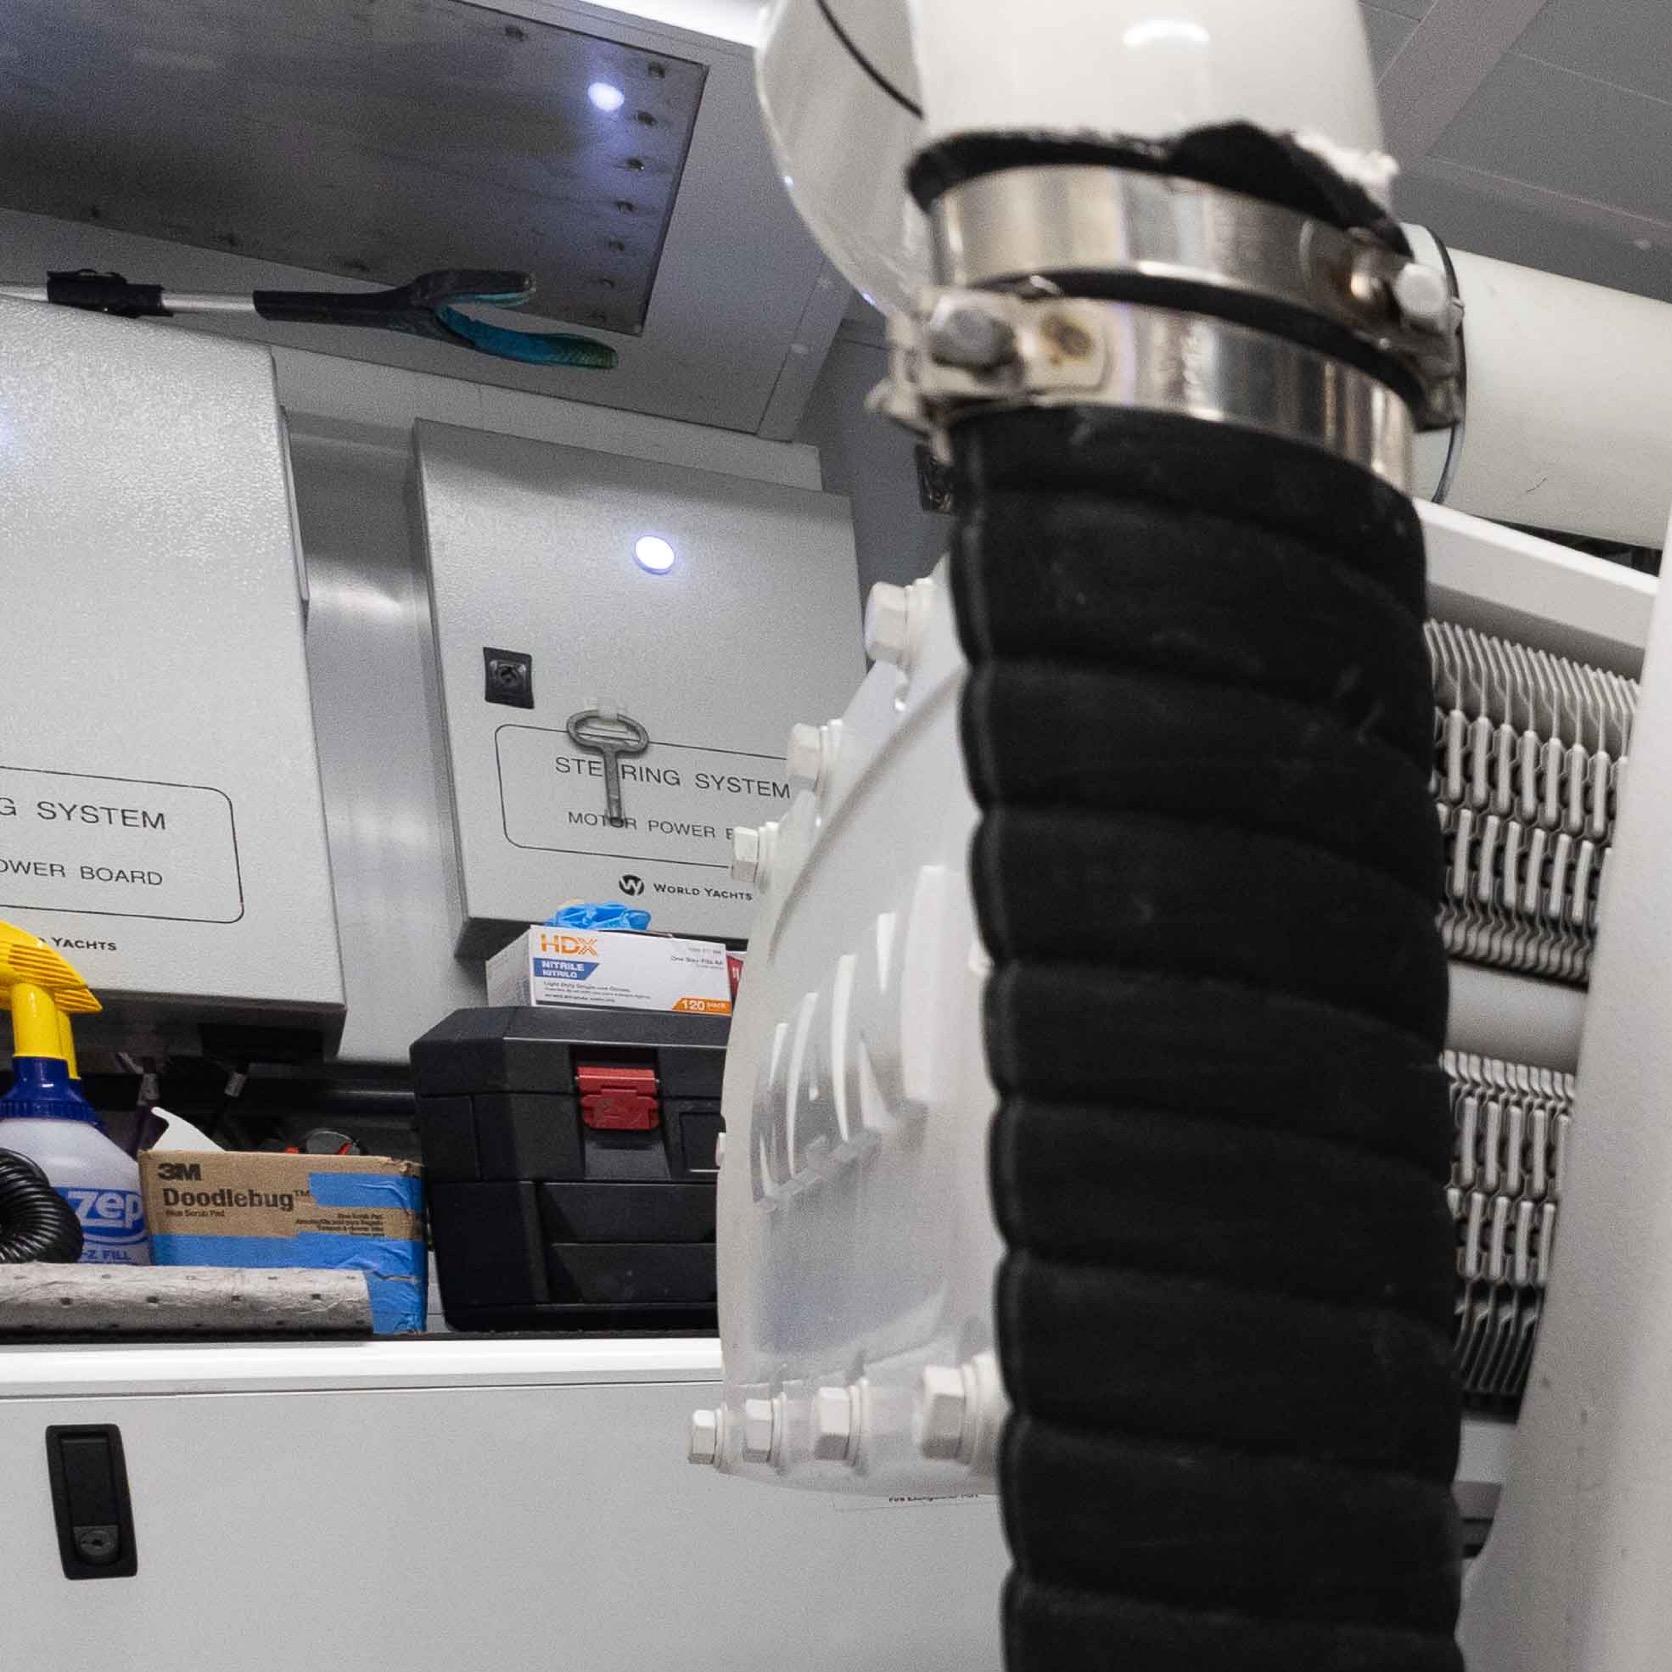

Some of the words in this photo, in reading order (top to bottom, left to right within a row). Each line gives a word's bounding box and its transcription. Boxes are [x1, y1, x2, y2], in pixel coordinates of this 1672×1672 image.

[555, 757, 680, 786] STERING
[695, 773, 790, 799] SYSTEM
[37, 801, 166, 830] SYSTEM
[648, 820, 716, 838] POWER
[80, 866, 163, 886] BOARD
[653, 883, 700, 896] WORLD
[704, 887, 753, 901] YACHTS
[51, 936, 117, 951] YACHTS
[540, 933, 598, 957] HDX
[541, 960, 585, 972] NITRILE
[542, 969, 578, 979] NITRILO
[681, 999, 705, 1011] 120
[158, 1163, 202, 1181] 3M
[103, 1250, 132, 1261] FILL
